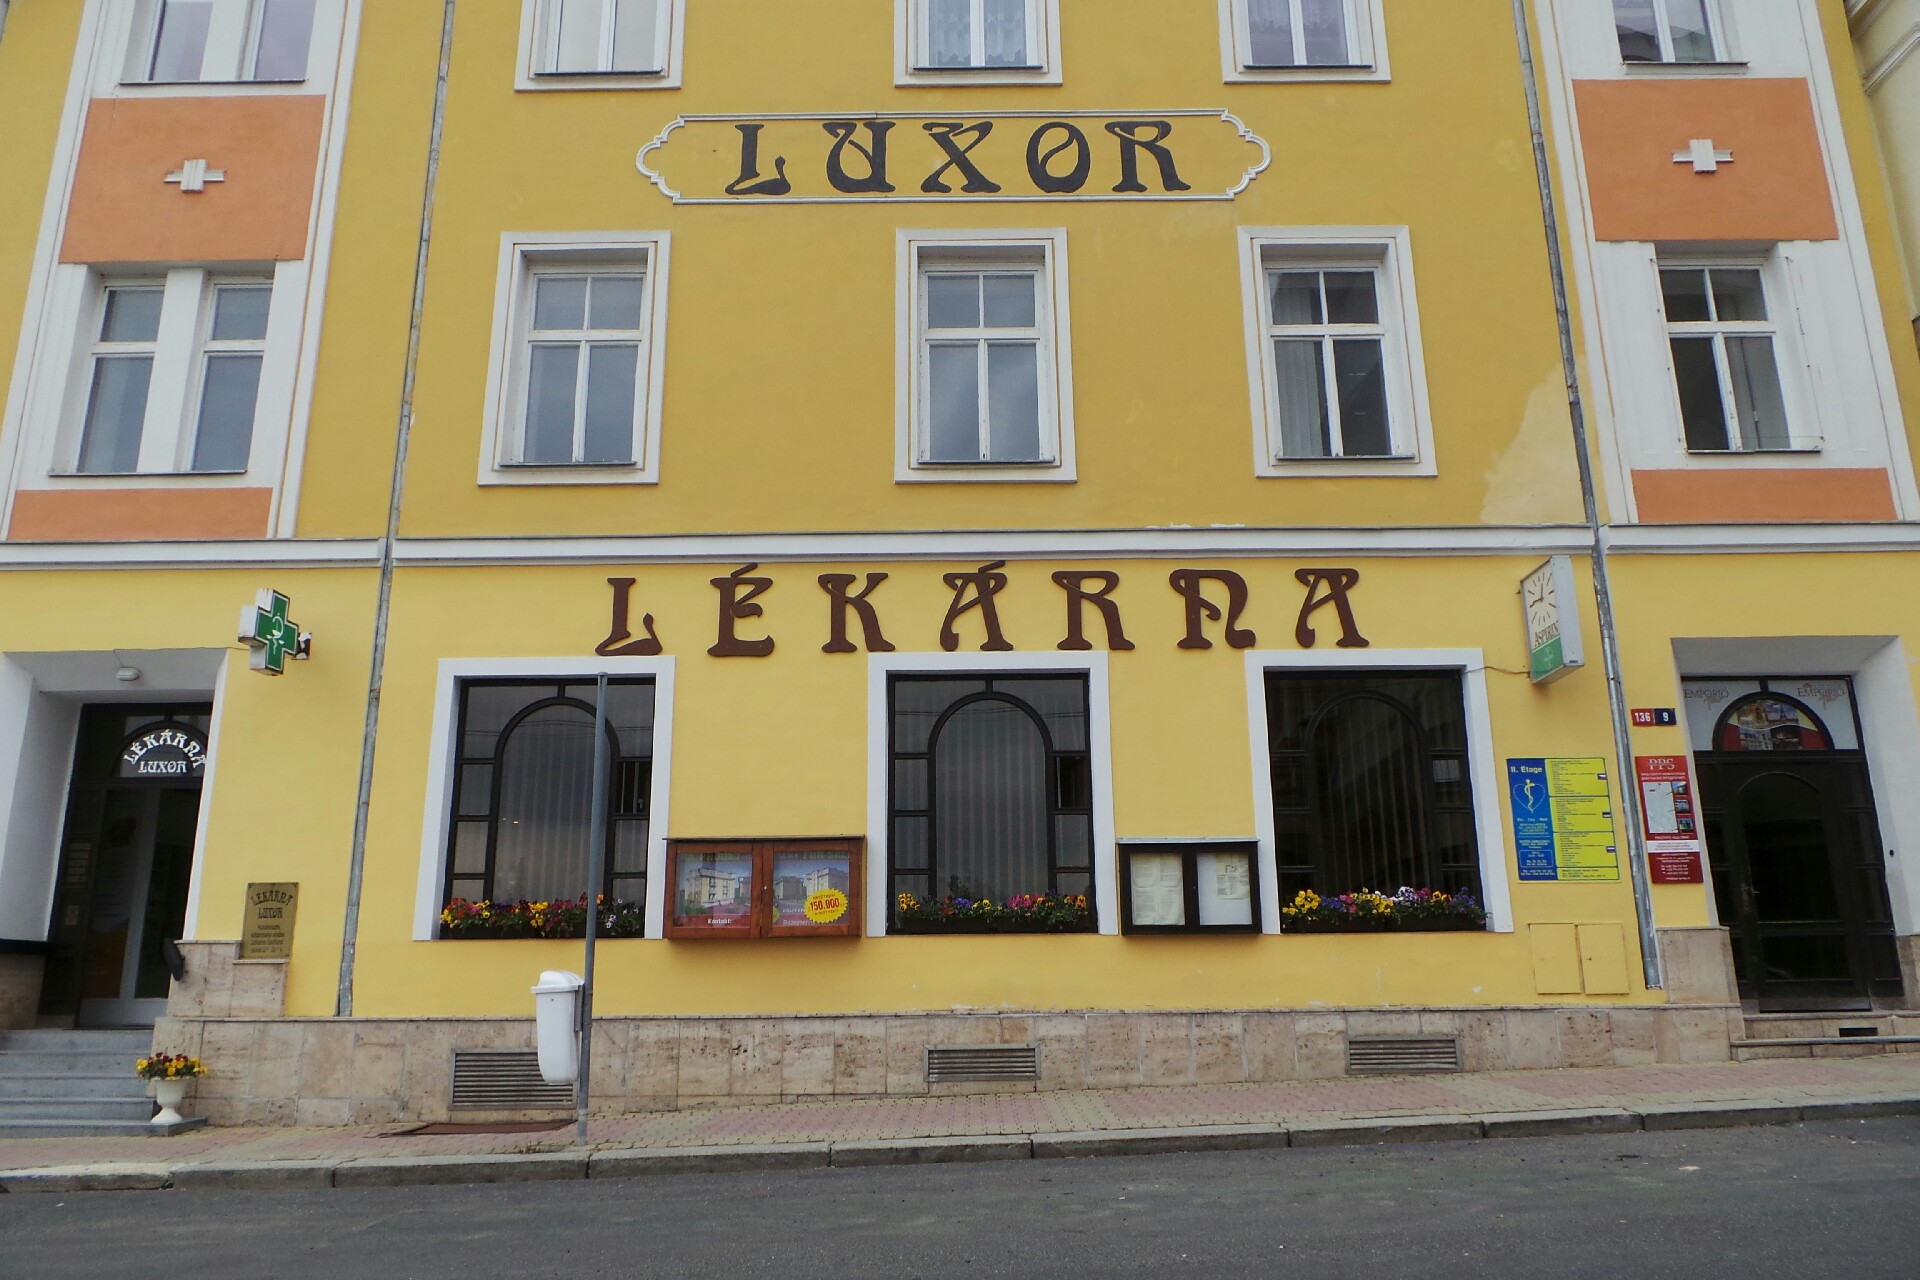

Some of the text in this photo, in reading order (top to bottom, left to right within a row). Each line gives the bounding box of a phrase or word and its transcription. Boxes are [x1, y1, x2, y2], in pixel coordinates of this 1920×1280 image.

[725, 120, 1192, 196] LUXOR
[595, 562, 1370, 658] LÉKÁRNA
[1534, 620, 1560, 648] ASPIRIN
[1684, 688, 1729, 699] EMPORIO
[1797, 687, 1845, 698] EMPORIO
[1634, 712, 1651, 723] 136
[1662, 711, 1669, 722] 9
[123, 728, 207, 769] LÉKÁRNA
[138, 760, 187, 773] LUXOR
[1648, 758, 1675, 770] PPS
[809, 897, 840, 912] 150.000
